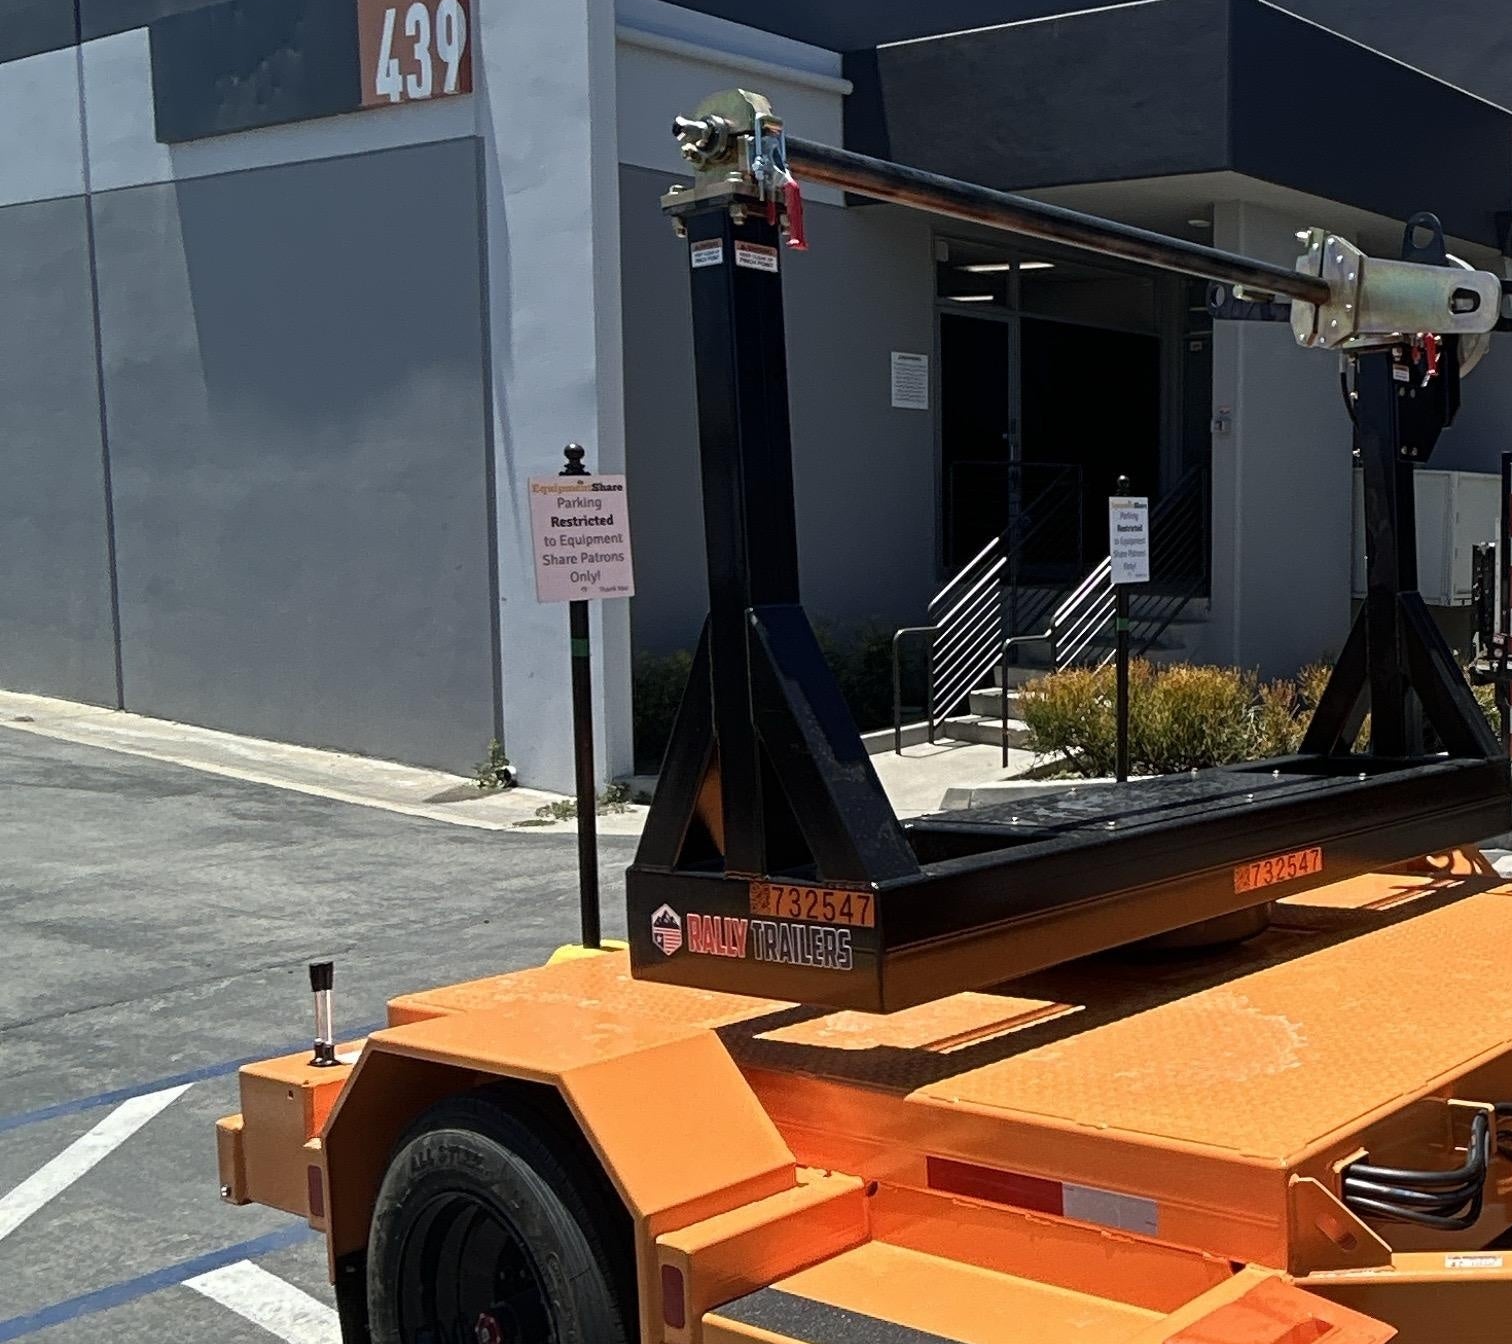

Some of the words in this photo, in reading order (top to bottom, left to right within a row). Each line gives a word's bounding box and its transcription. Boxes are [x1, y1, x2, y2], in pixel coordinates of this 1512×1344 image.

[557, 497, 602, 511] Parking
[551, 514, 614, 528] Restricted
[544, 536, 556, 547] to
[560, 534, 623, 548] Equipment
[542, 554, 578, 566] Share
[581, 552, 625, 564] Patrons
[570, 570, 601, 584] Only!
[1251, 849, 1319, 887] 732547
[771, 886, 871, 925] 732547
[686, 912, 748, 958] RALLY
[750, 920, 853, 971] TRAILERS
